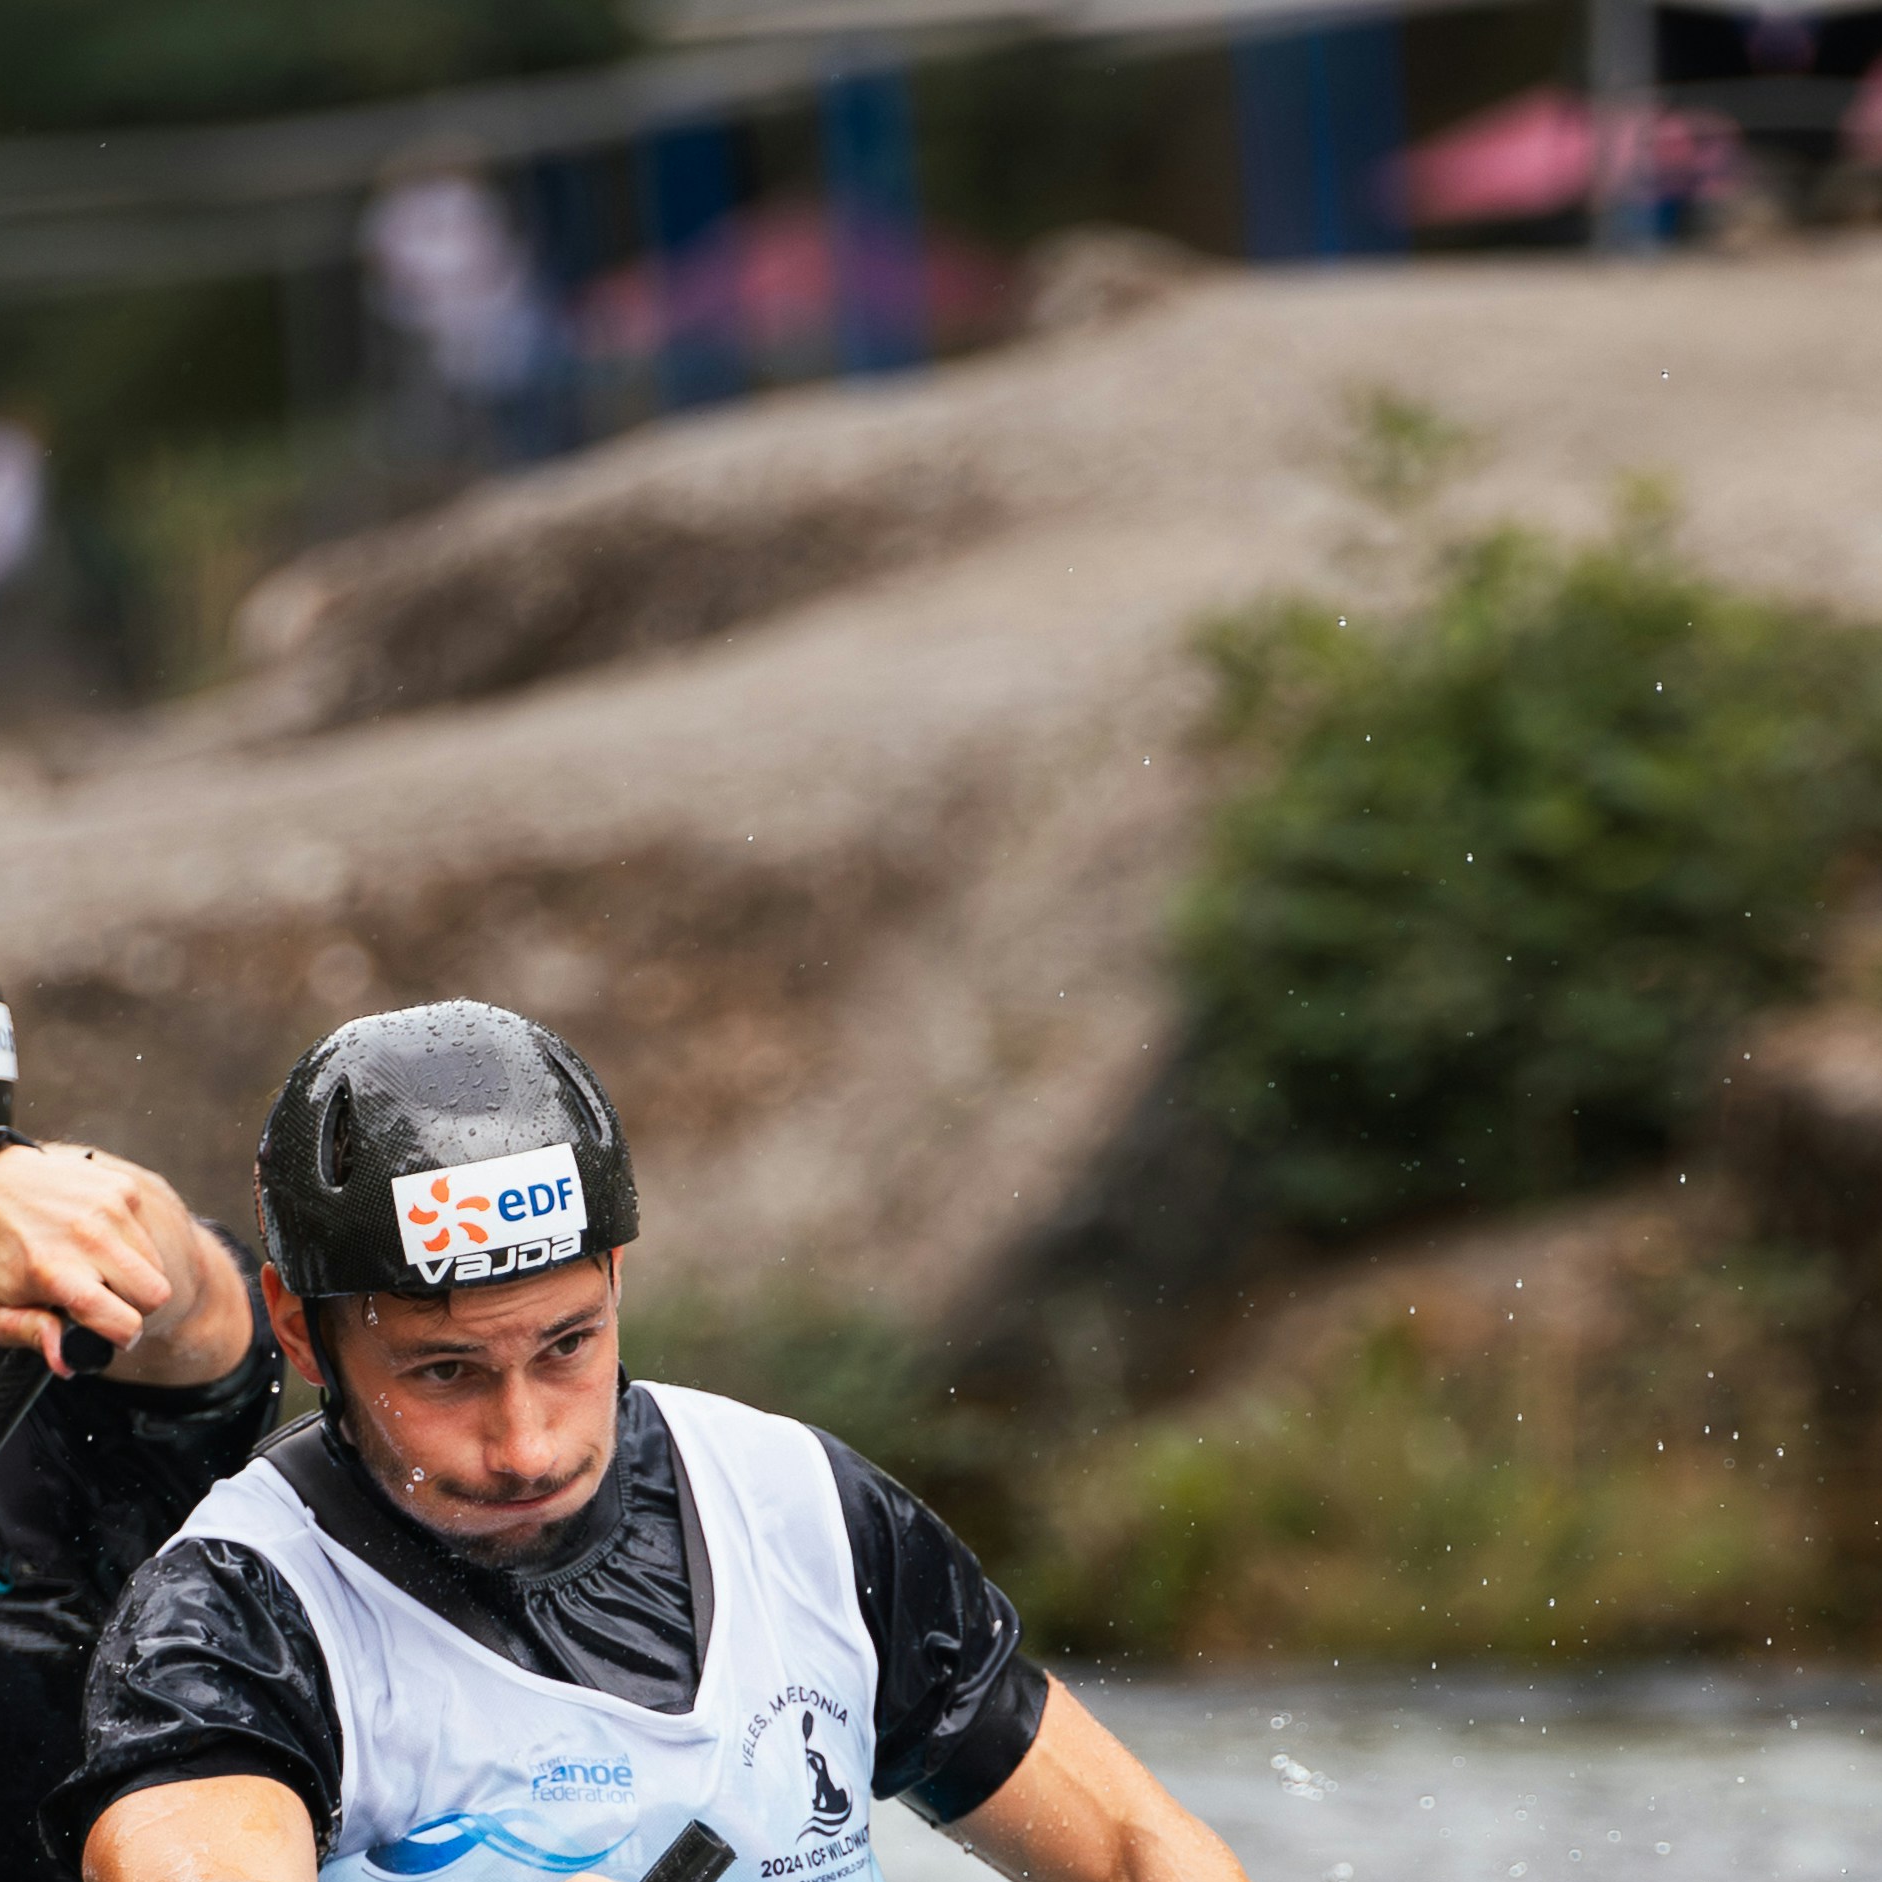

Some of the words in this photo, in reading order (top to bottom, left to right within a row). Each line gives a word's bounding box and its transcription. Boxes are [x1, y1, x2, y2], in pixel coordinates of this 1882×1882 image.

[742, 1713, 773, 1769] VELES,
[760, 1854, 804, 1879] 2024
[804, 1846, 827, 1869] ICF
